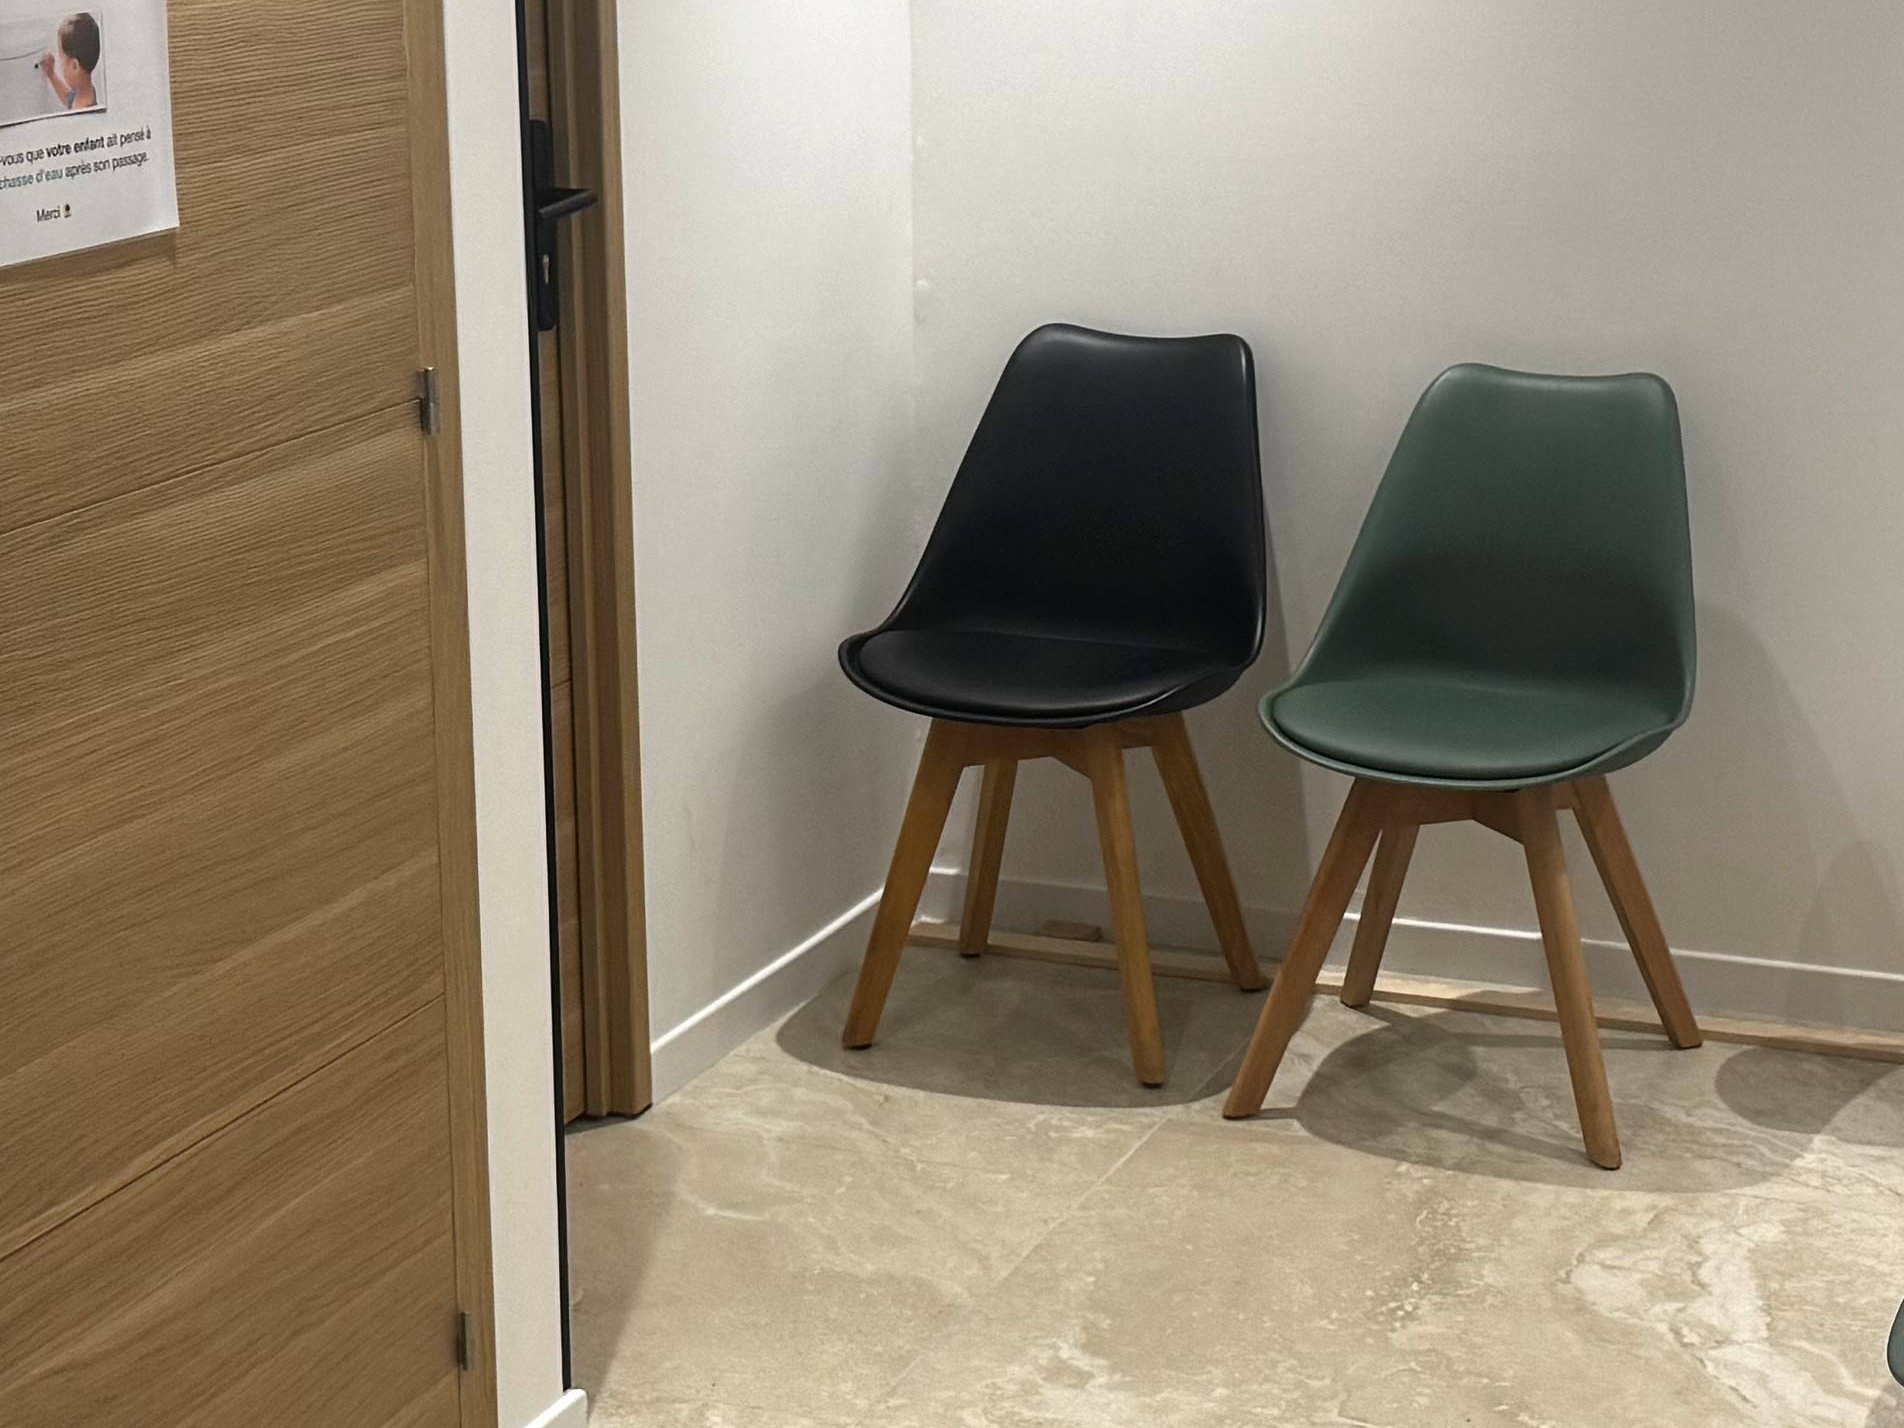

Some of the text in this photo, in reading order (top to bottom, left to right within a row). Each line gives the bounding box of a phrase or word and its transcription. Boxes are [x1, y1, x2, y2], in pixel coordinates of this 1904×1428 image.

[25, 148, 44, 164] que
[45, 143, 72, 158] votre
[72, 135, 105, 153] enfant
[106, 132, 118, 148] ait
[119, 127, 144, 147] pensé
[35, 167, 63, 183] d'eau
[64, 160, 92, 180] après
[92, 159, 110, 172] son
